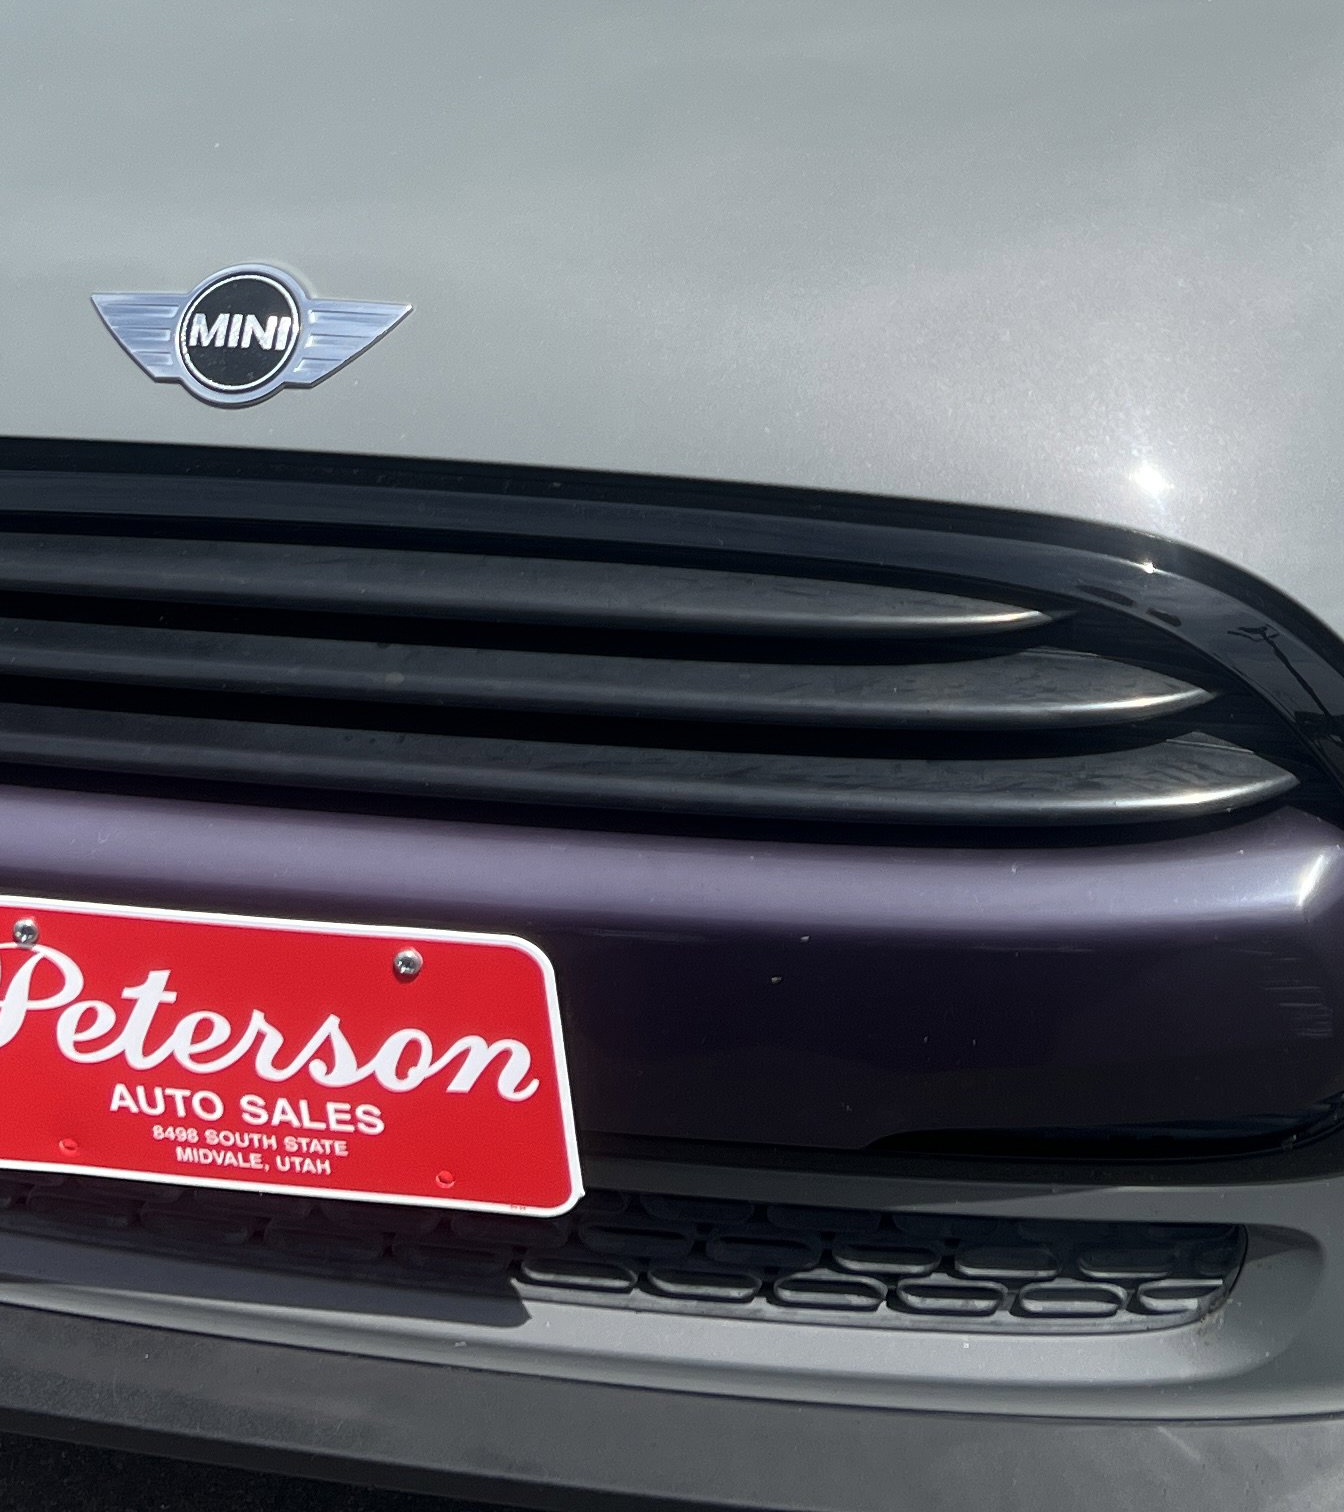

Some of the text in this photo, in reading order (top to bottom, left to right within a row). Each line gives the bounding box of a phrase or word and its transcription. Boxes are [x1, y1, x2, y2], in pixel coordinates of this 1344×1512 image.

[189, 313, 292, 351] MINI
[109, 1083, 385, 1135] AUTO SALES
[152, 1124, 349, 1157] 8498 SOUTH STATE
[175, 1145, 332, 1175] MIDVALE, UTAH
